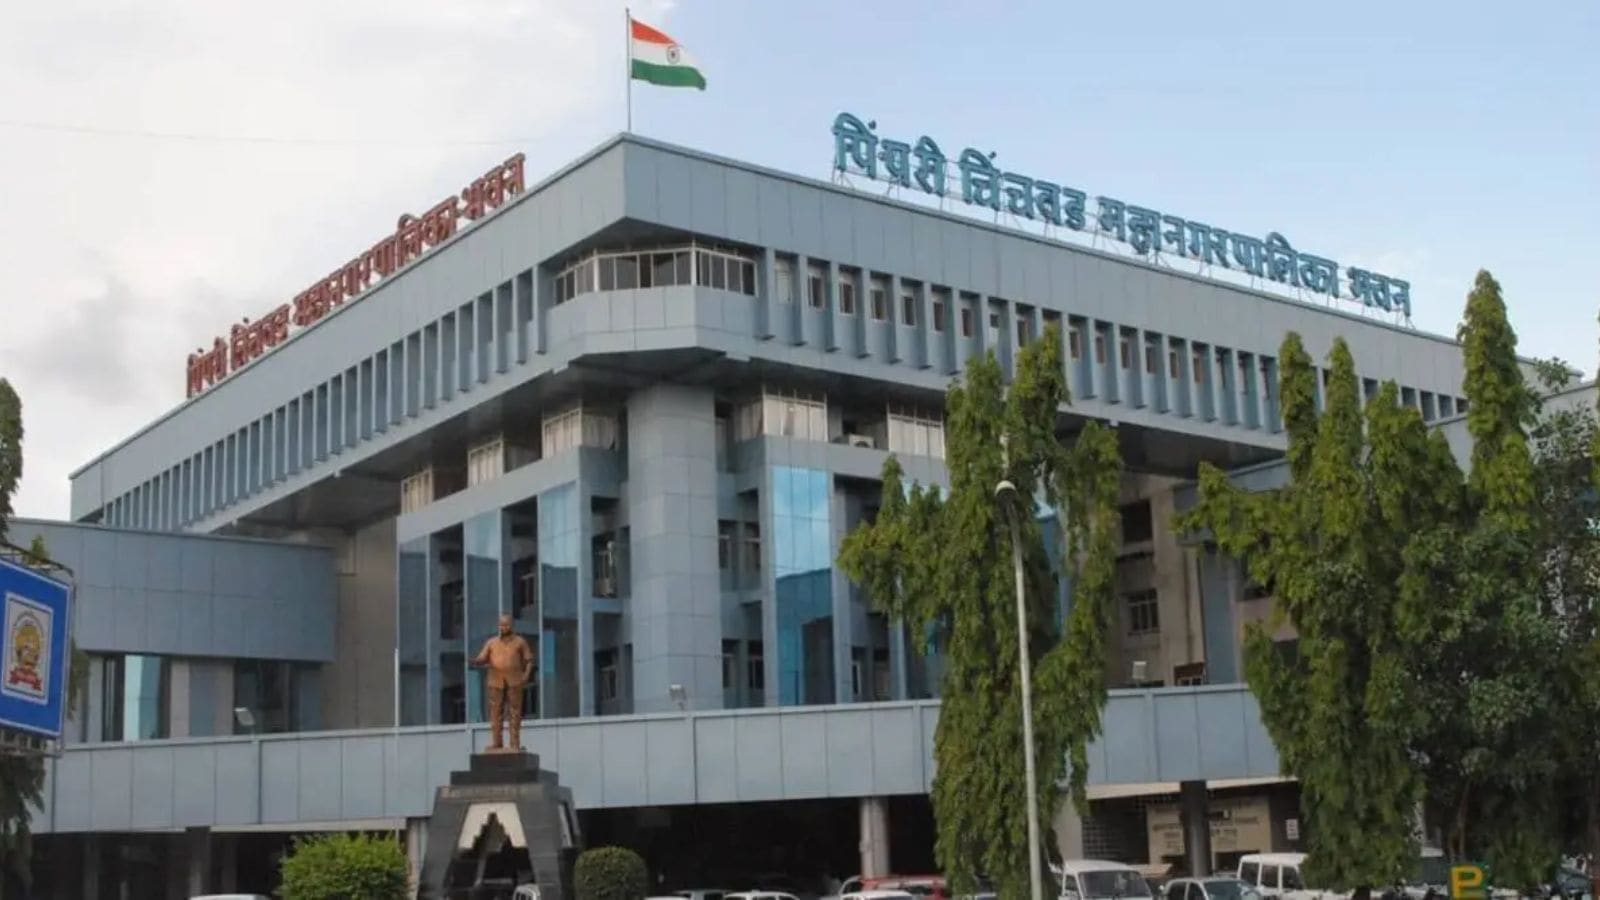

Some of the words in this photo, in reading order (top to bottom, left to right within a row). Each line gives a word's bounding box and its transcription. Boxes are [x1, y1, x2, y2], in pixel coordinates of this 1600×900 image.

[230, 303, 290, 371] चिंचवड
[292, 195, 460, 327] महानगरपालिका
[462, 152, 526, 220] भवन
[831, 112, 946, 197] पिंपरी
[958, 147, 1087, 231] चिंचवड
[1096, 195, 1339, 298] महानगरपालिका
[1347, 266, 1411, 317] भवन
[1450, 864, 1483, 899] P
